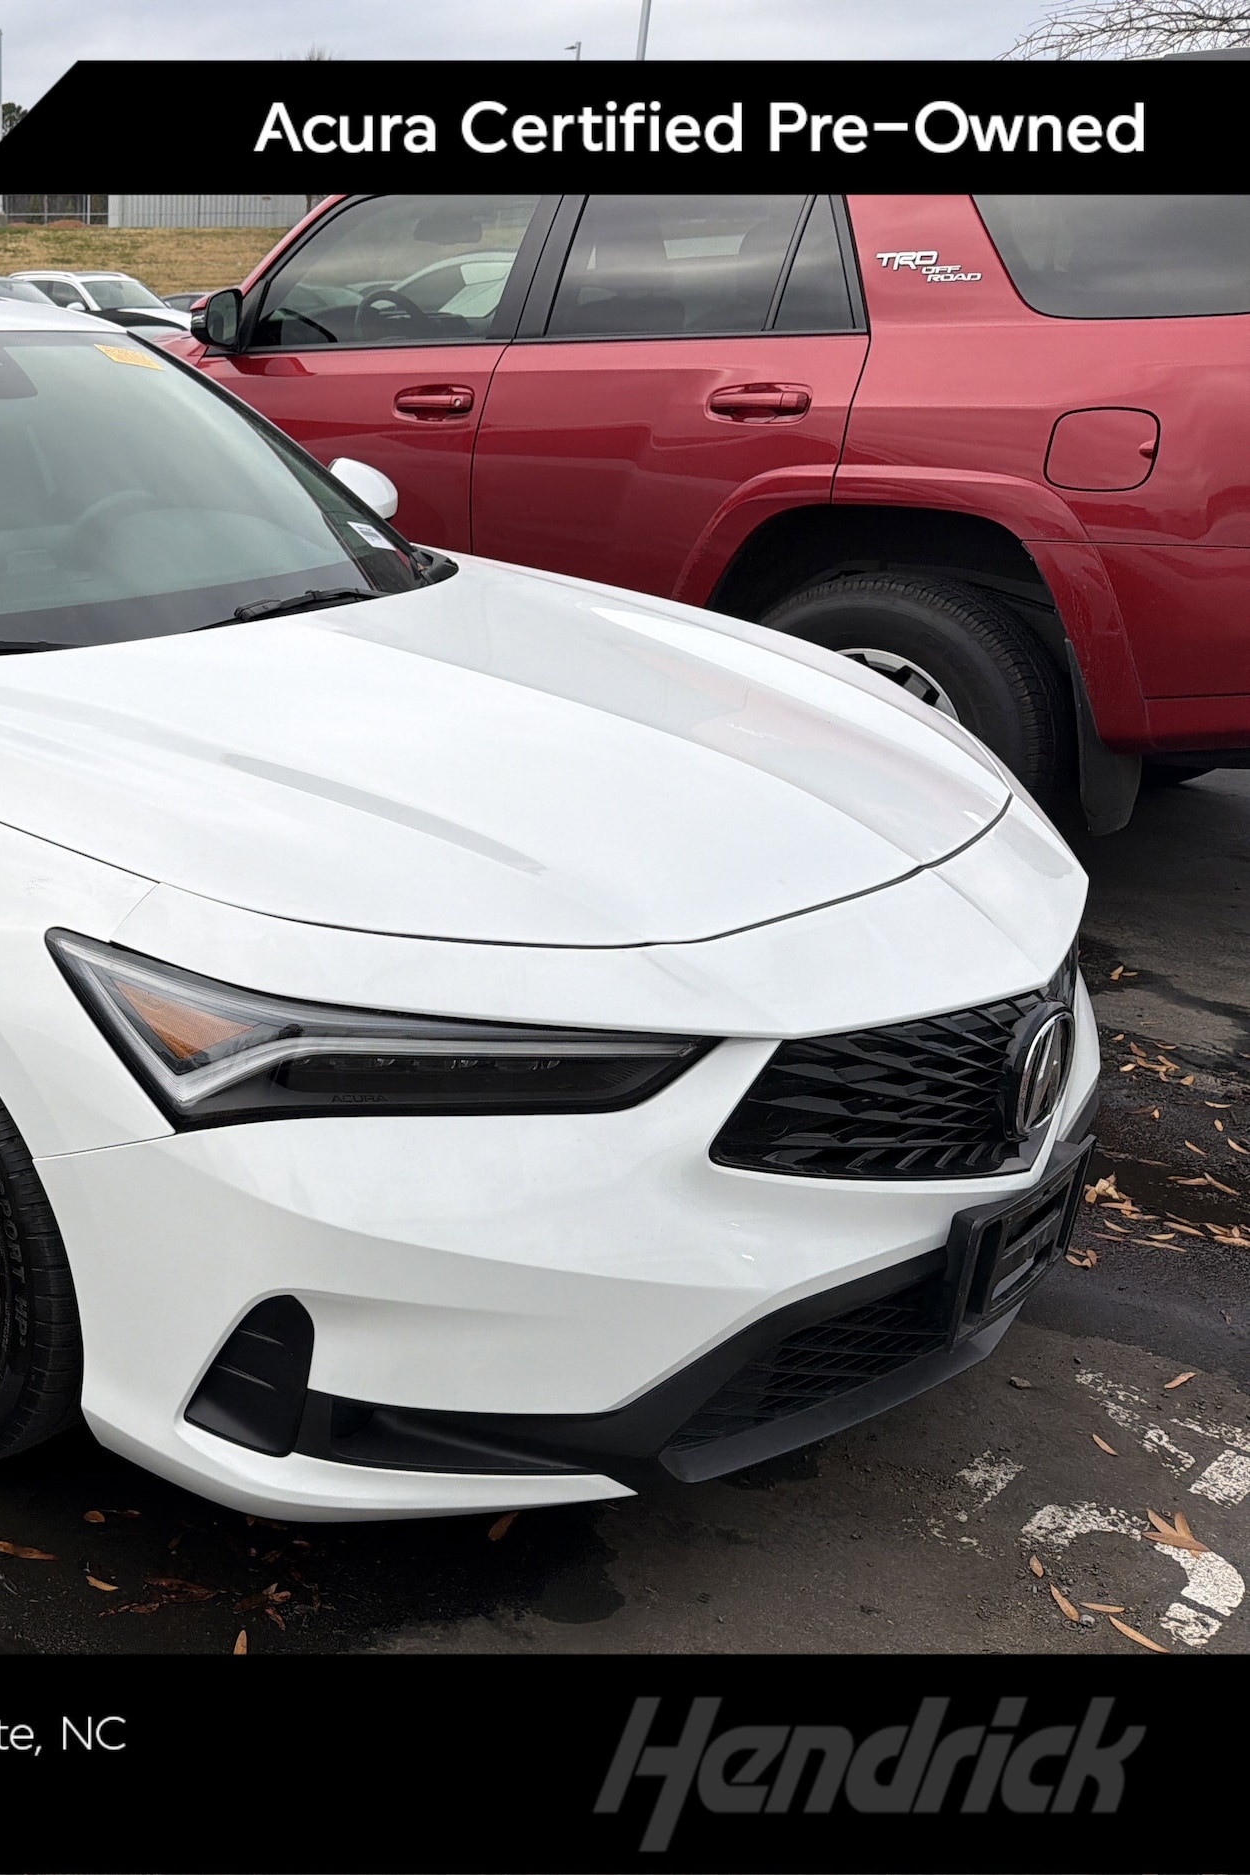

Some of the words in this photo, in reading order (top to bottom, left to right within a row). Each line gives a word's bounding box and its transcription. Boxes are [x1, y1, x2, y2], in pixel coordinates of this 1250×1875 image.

[875, 250, 939, 271] TRD
[921, 264, 962, 274] OFF
[926, 272, 982, 283] ROAD
[331, 1093, 388, 1104] ACURA
